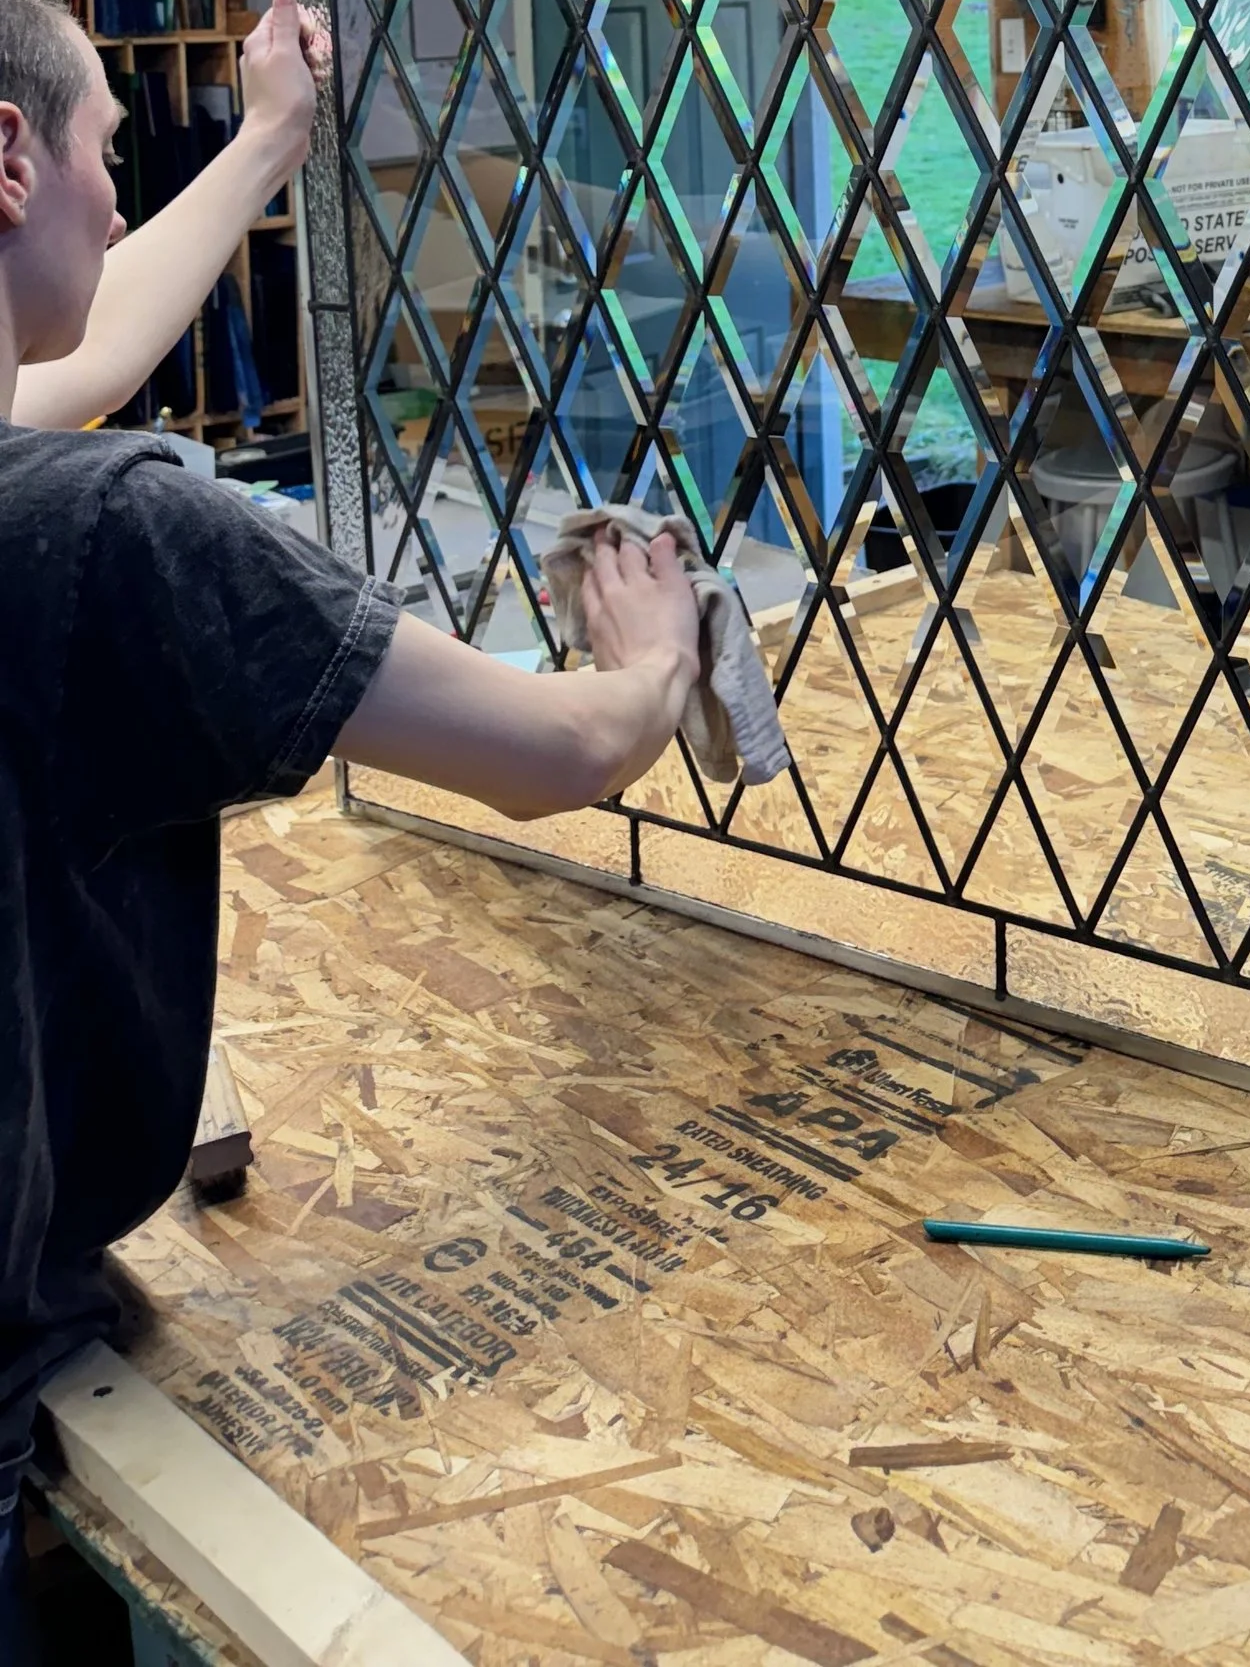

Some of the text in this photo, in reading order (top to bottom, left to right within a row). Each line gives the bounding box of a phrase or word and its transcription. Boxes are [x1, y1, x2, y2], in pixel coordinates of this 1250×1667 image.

[1172, 176, 1250, 193] NOT FOR PRIVATE USE
[1194, 210, 1248, 232] STATE
[1195, 235, 1237, 254] SERV
[744, 1090, 900, 1161] APA
[630, 1143, 780, 1221] 24/16
[673, 1119, 828, 1201] RATED SHEATHING
[539, 1185, 624, 1239] THICKNESS
[588, 1183, 682, 1240] EXPOSURE
[546, 1230, 614, 1270] 454
